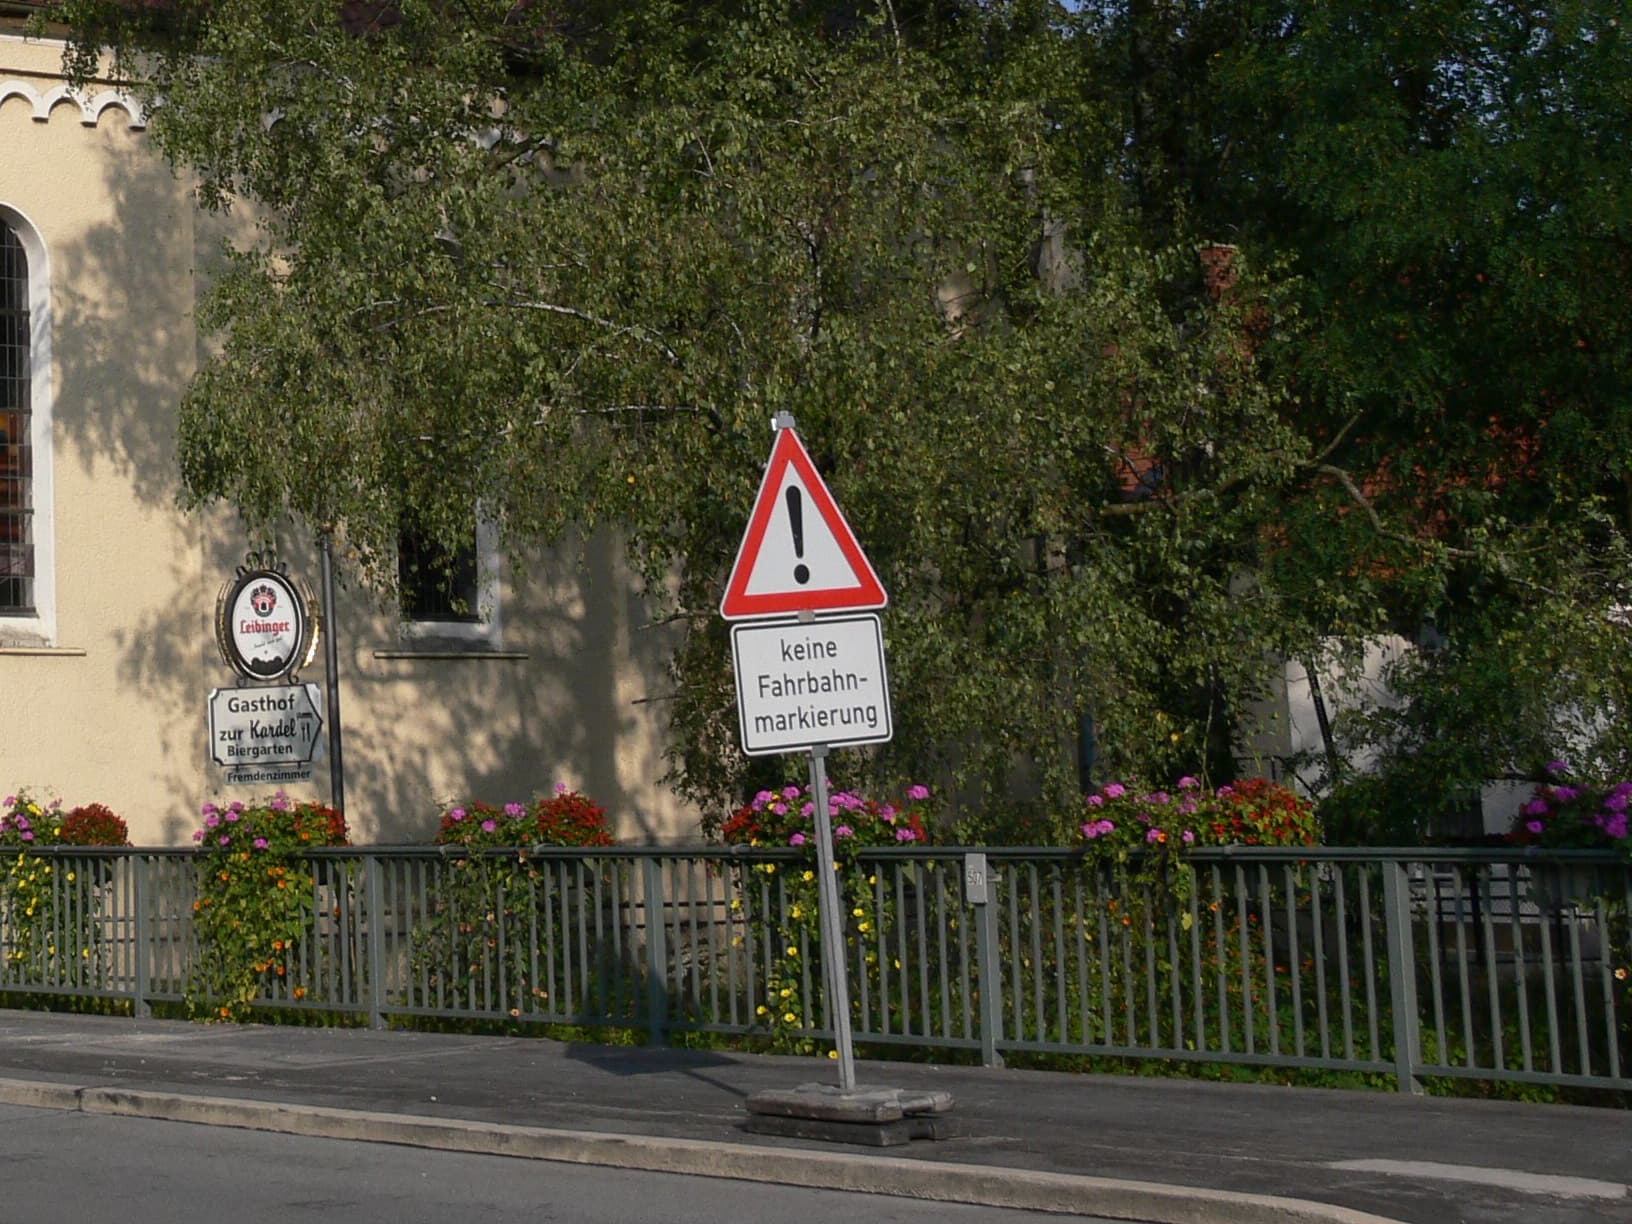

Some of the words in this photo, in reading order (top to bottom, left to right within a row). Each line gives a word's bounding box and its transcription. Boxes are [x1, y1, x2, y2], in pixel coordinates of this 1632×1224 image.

[240, 619, 290, 636] Leibinger
[780, 637, 838, 662] keine
[757, 669, 868, 698] Fahrbahn-
[227, 693, 295, 713] Gasthof
[754, 704, 878, 733] markierung
[219, 728, 244, 742] zur
[249, 718, 297, 739] Kardel
[227, 743, 293, 758] Biergarten
[227, 769, 311, 783] Fremdenzimmer
